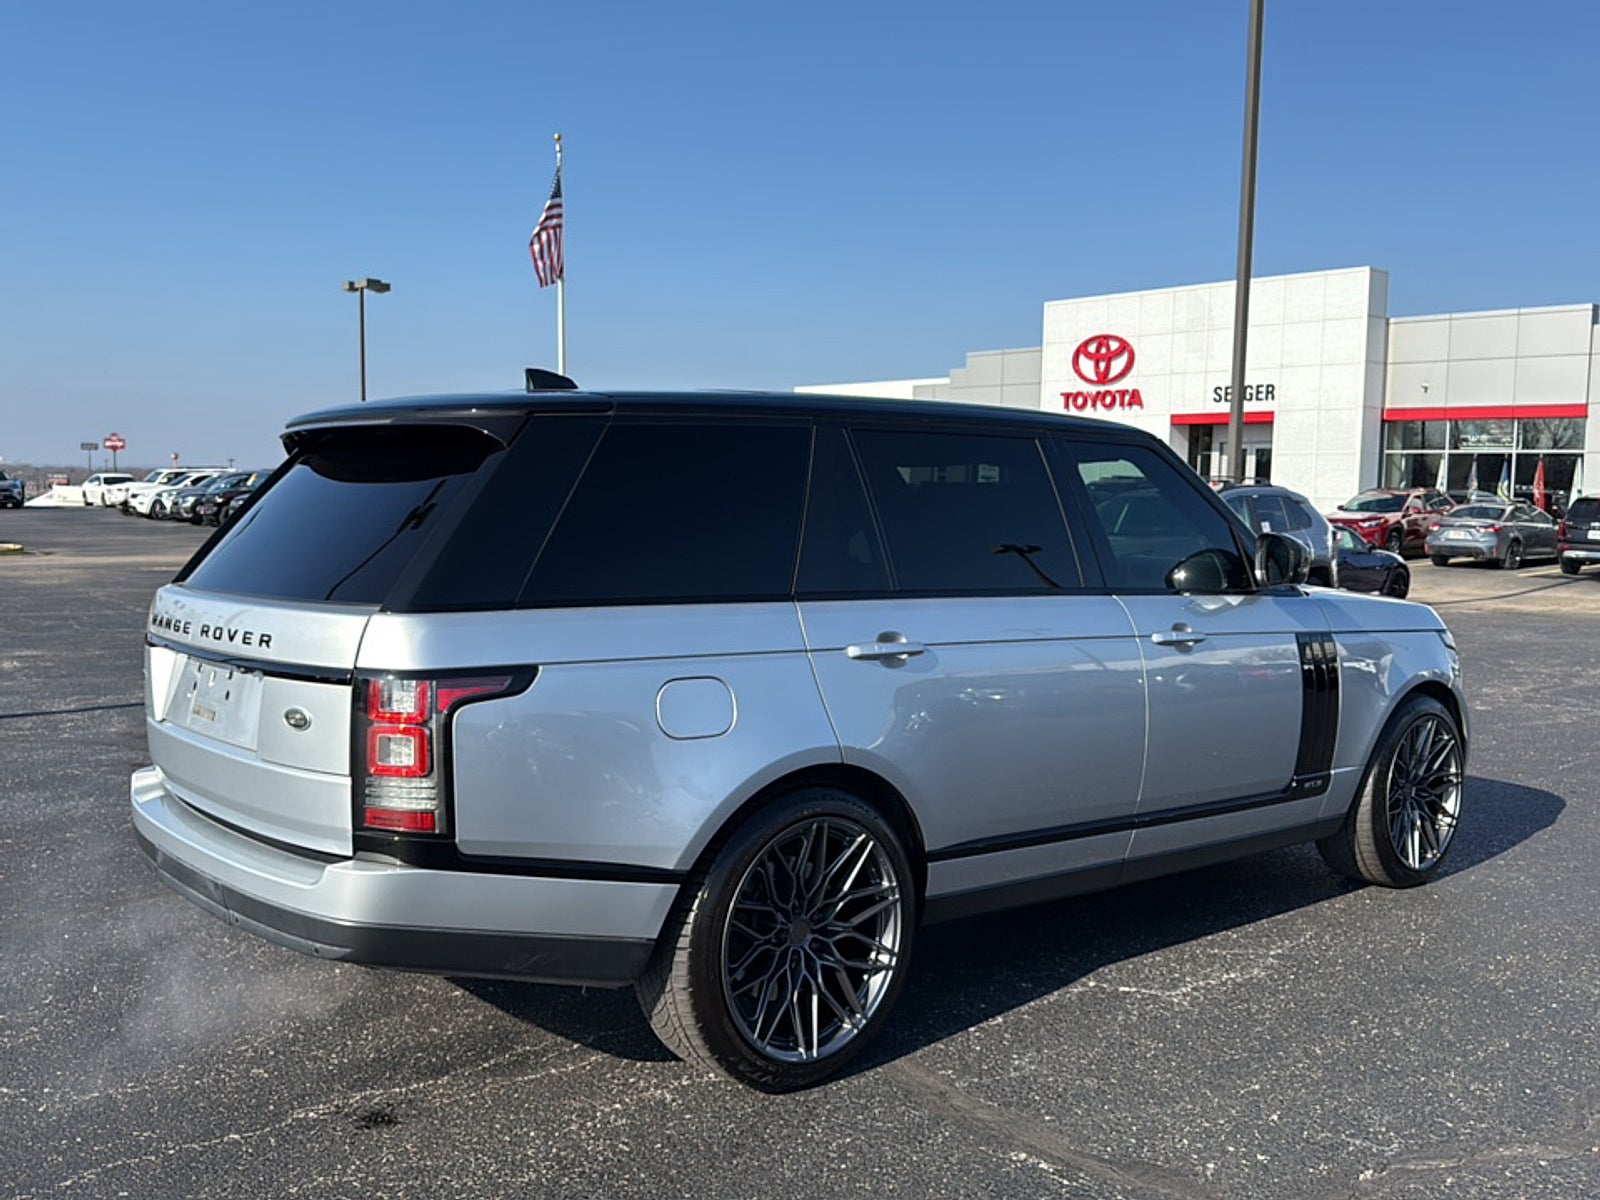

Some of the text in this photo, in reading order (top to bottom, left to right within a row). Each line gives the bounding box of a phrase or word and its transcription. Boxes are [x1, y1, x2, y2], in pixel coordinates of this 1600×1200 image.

[1060, 388, 1143, 411] TOYOTA
[1213, 384, 1275, 403] SEGER
[200, 624, 273, 649] ROVER
